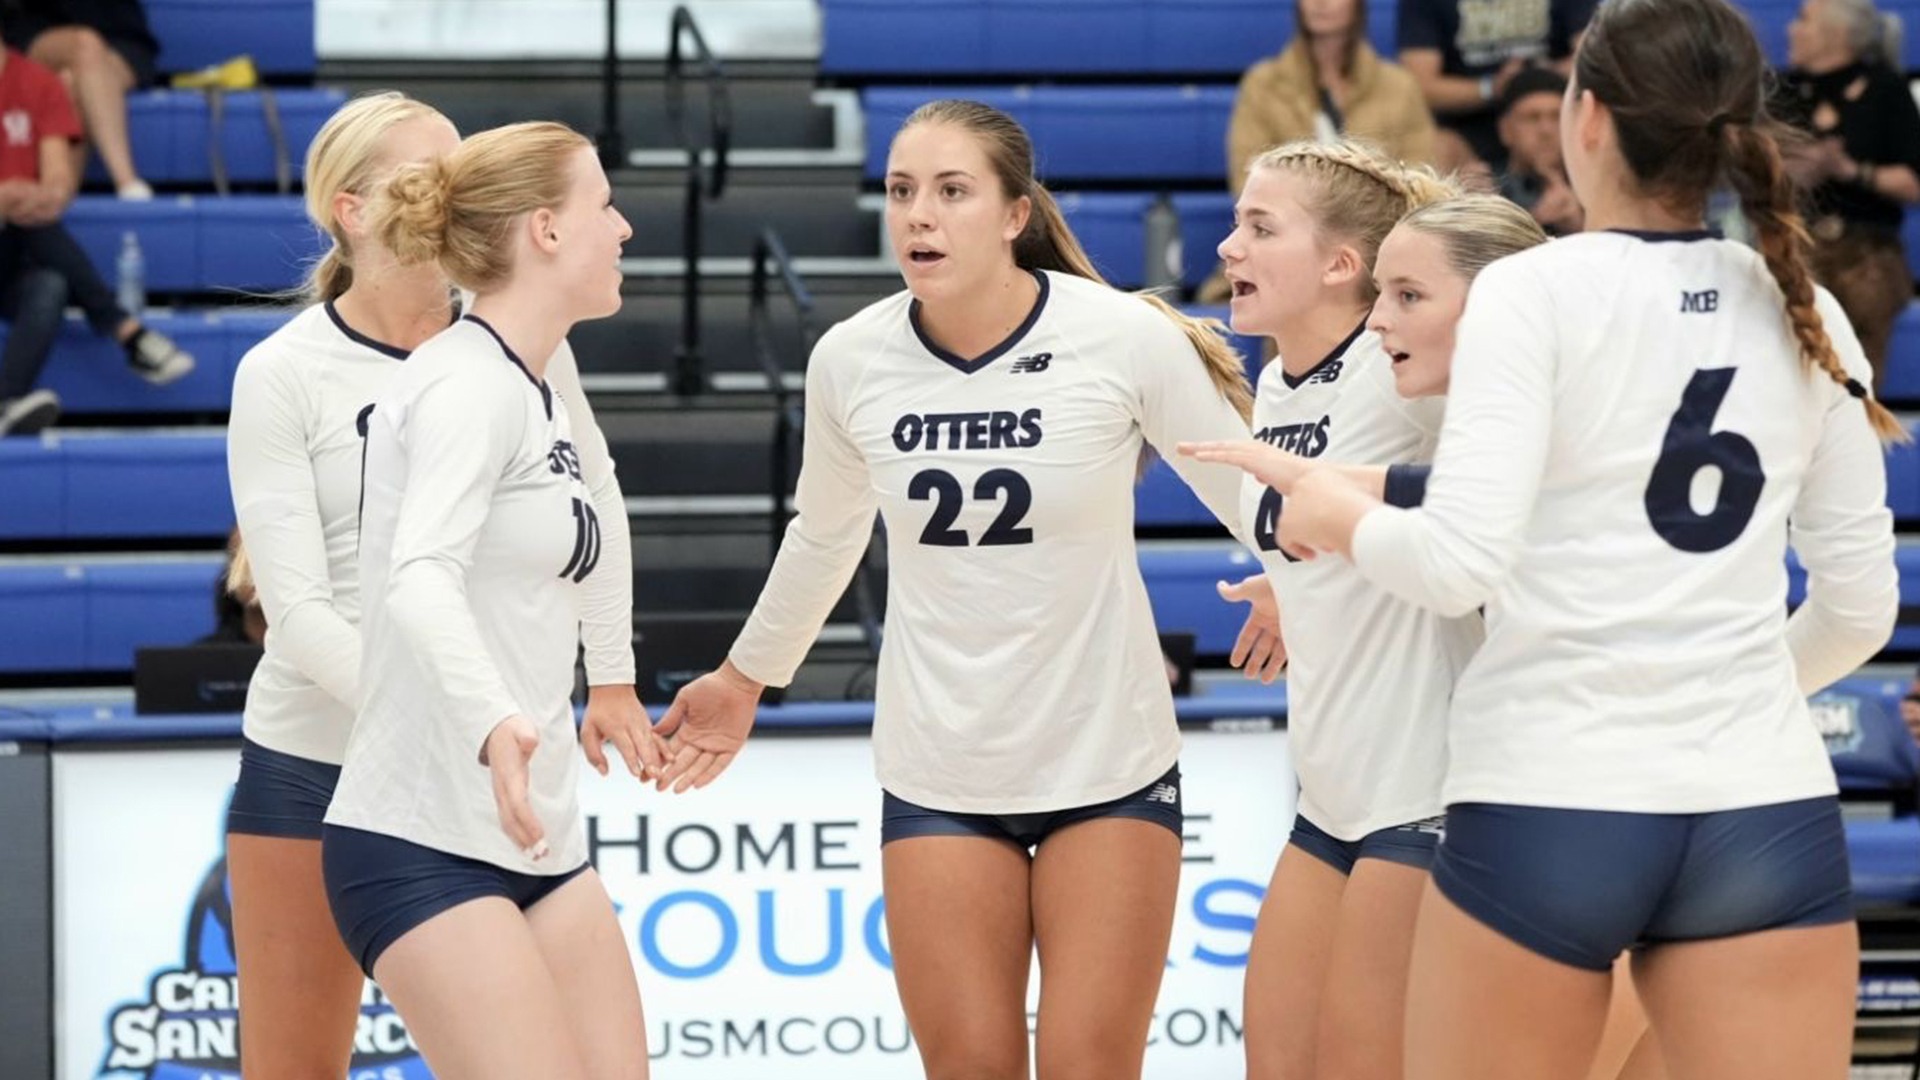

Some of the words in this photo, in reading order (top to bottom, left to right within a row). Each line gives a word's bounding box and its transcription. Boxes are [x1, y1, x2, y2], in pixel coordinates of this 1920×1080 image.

[1680, 289, 1718, 313] MB
[891, 408, 1042, 452] OTTERS
[1643, 366, 1766, 554] 6
[908, 468, 1034, 547] 22
[558, 497, 601, 584] 10
[586, 815, 861, 875] HOME
[108, 1007, 239, 1068] SAN
